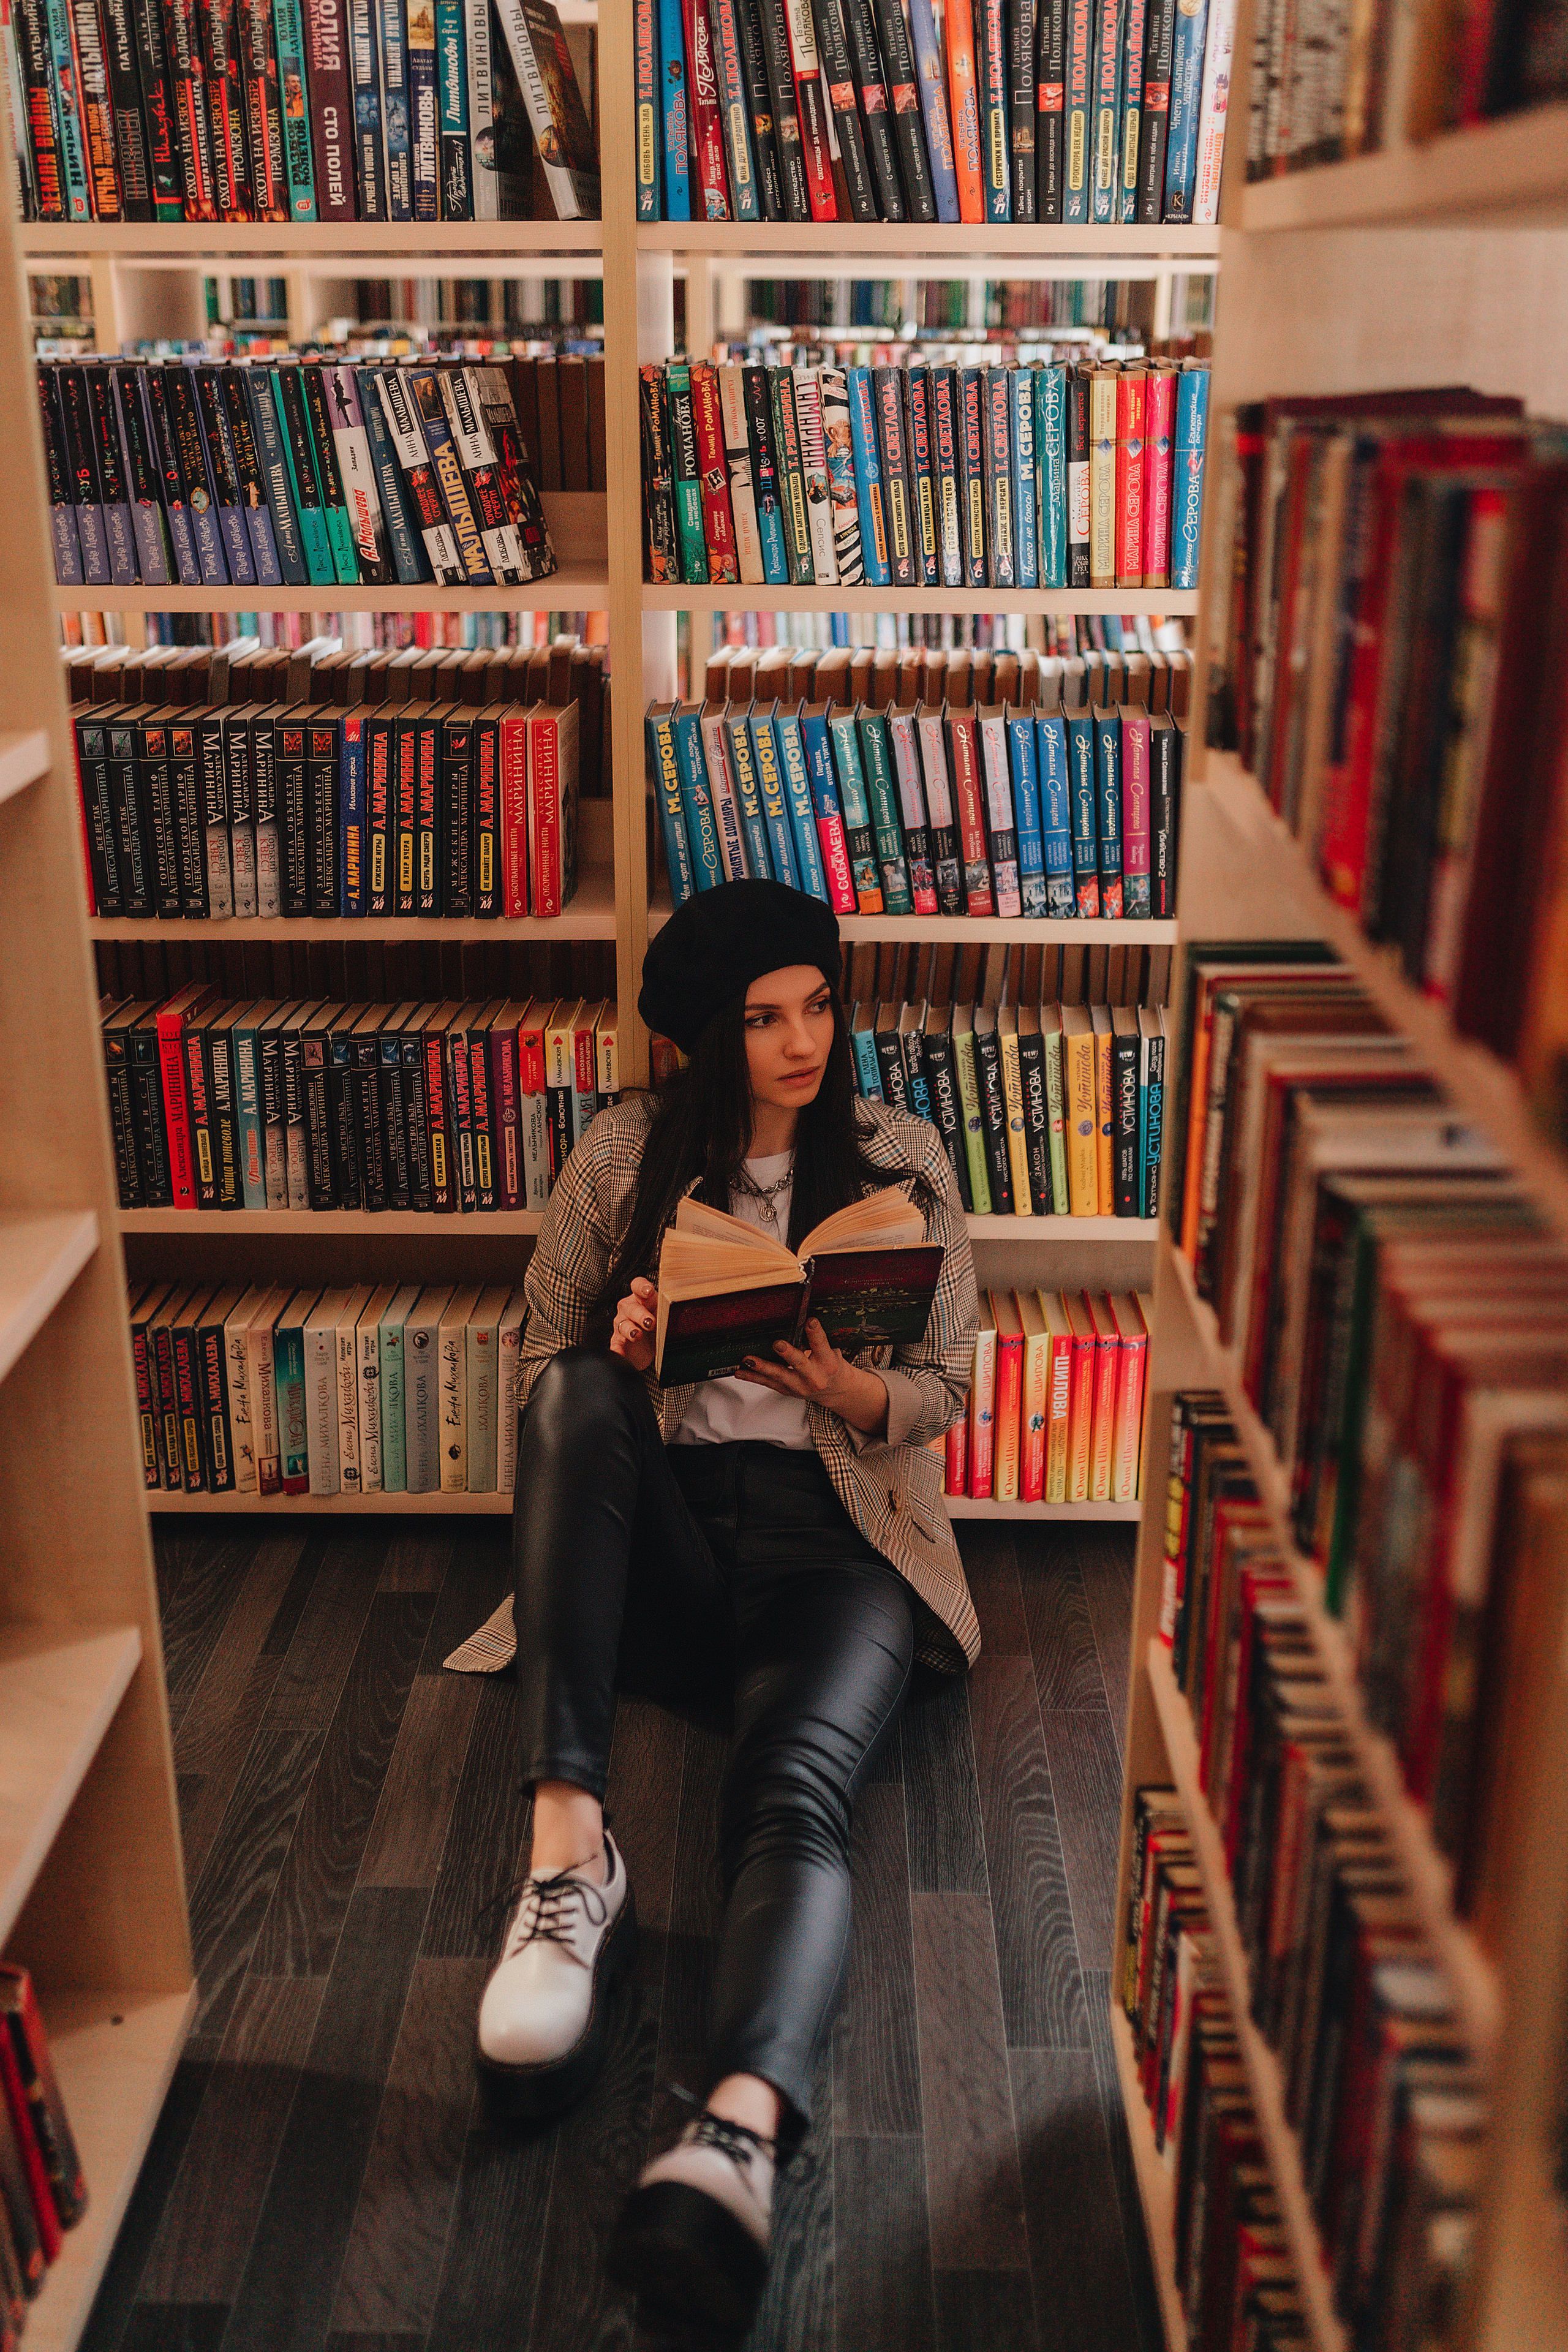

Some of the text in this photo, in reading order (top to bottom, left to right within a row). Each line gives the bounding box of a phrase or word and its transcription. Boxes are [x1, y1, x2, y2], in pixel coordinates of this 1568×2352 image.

[75, 2, 105, 92] ЛАТЫНИНА
[473, 4, 489, 113] ЛИТВИНОВЫ
[510, 9, 548, 113] ЛИТВИНОВЫ
[853, 19, 867, 58] Татьяна
[859, 3, 879, 72] Полякова
[1072, 0, 1088, 105] Т. ПОЛЯКОВА
[1150, 15, 1160, 55] Татьяна
[192, 81, 203, 106] САГА
[445, 37, 461, 123] Литвиновы
[29, 87, 62, 212] ЗЕМЛЯ ВОЙНЫ
[64, 119, 83, 186] НИЧЬЯ
[88, 103, 102, 164] ТОЛЬКО ГОЛУБИ
[117, 108, 148, 198] НИЯЗБЕК
[197, 108, 211, 198] ОЛИГАРХИЧЕСКАЯ
[230, 108, 244, 181] ПРОМЗОНА
[268, 107, 282, 180] ПРОМЗОНА
[287, 119, 303, 185] РАЗБОР
[295, 118, 311, 185] ПОЛЕТОВ
[324, 106, 346, 205] СТО ПОЛЕЙ
[418, 85, 435, 182] ЛИТВИНОВЫ
[642, 124, 650, 146] ОЧЕНЬ
[674, 88, 687, 174] ПОЛЯКОВА
[733, 106, 747, 180] МОЙ ДРУГ ТАРАНТИНО
[807, 83, 824, 179] ОХОТНИЦЫ ЗА ПРИВИДЕНИЯМИ
[963, 86, 980, 170] ПОЛЯКОВА
[993, 111, 1001, 138] ПРОМАХ
[1074, 112, 1082, 137] НЕДОЛОГ
[1128, 133, 1137, 164] ПУШИСТЫХ
[95, 167, 118, 213] НИЧЬЯ
[399, 152, 409, 208] БЛОНДИНКА
[643, 149, 651, 179] ЛЮБОВЬ
[765, 167, 774, 194] Небеса
[772, 172, 782, 208] рассудили
[790, 160, 800, 207] Наследство
[796, 156, 807, 213] бизнес-класса
[883, 148, 892, 173] чистого
[993, 149, 1003, 186] СЕСТРИЧКИ
[387, 377, 415, 432] МАЛЫШЕВА
[679, 395, 697, 476] РОМАНОВА
[780, 377, 799, 469] Т. РЯБИНИНА
[797, 380, 825, 467] САМАРИНА
[913, 379, 930, 472] Т. СВЕТЛОВА
[967, 380, 981, 473] Т. СВЕТЛОВА
[1018, 378, 1033, 480] М. СЕРОВА
[349, 446, 358, 471] Западня
[404, 432, 420, 458] АННА
[1076, 434, 1085, 450] Все
[269, 462, 293, 530] МАЛЫШЕВА
[380, 462, 405, 529] МАЛЫШЕВА
[416, 487, 434, 524] ХОЛОДНЕЕ
[426, 488, 441, 517] СМЕРТИ
[434, 439, 489, 575] МАЛЫШЕВА
[685, 488, 694, 526] Свидание
[792, 475, 807, 550] ОДНИМ АНГЕЛОМ МЕНЬШЕ
[922, 502, 932, 534] ГРЕШНИЦЫ
[1127, 463, 1140, 569] МАРИНА СЕРОВА
[816, 518, 826, 556] Сепсис
[1023, 491, 1034, 577] Ничего не боюсь!
[373, 731, 387, 830] А. МАРИНИНА
[421, 729, 434, 827] А. МАРИНИНА
[513, 726, 524, 824] МАРИНИНА
[657, 720, 682, 814] М. СЕРОВА
[177, 773, 191, 885] ГОРОДСКОЙ ТАРИФ
[720, 797, 737, 837] ДОЛЛАРЫ
[1021, 779, 1034, 826] Солнцева
[192, 829, 203, 895] АЛЕКСАНДРА
[347, 825, 360, 899] А. МАРИНИНА
[510, 850, 519, 897] ОБОРВАННЫЕ
[674, 821, 691, 899] Чем черт не шутит
[803, 822, 820, 891] стою миллионы
[1158, 829, 1167, 876] УБИЙСТВО-2
[187, 1035, 206, 1110] МАРИНИНА
[212, 1038, 231, 1111] А. МАРИНИНА
[1123, 1066, 1136, 1134] УСТИНОВА
[557, 1090, 566, 1129] болотная
[221, 1118, 236, 1202] Убийца поневоле
[205, 1334, 221, 1399] МИХАЛЕВА
[1053, 1355, 1070, 1419] ШИЛОВА
[339, 1365, 355, 1461] Елена Михалкова
